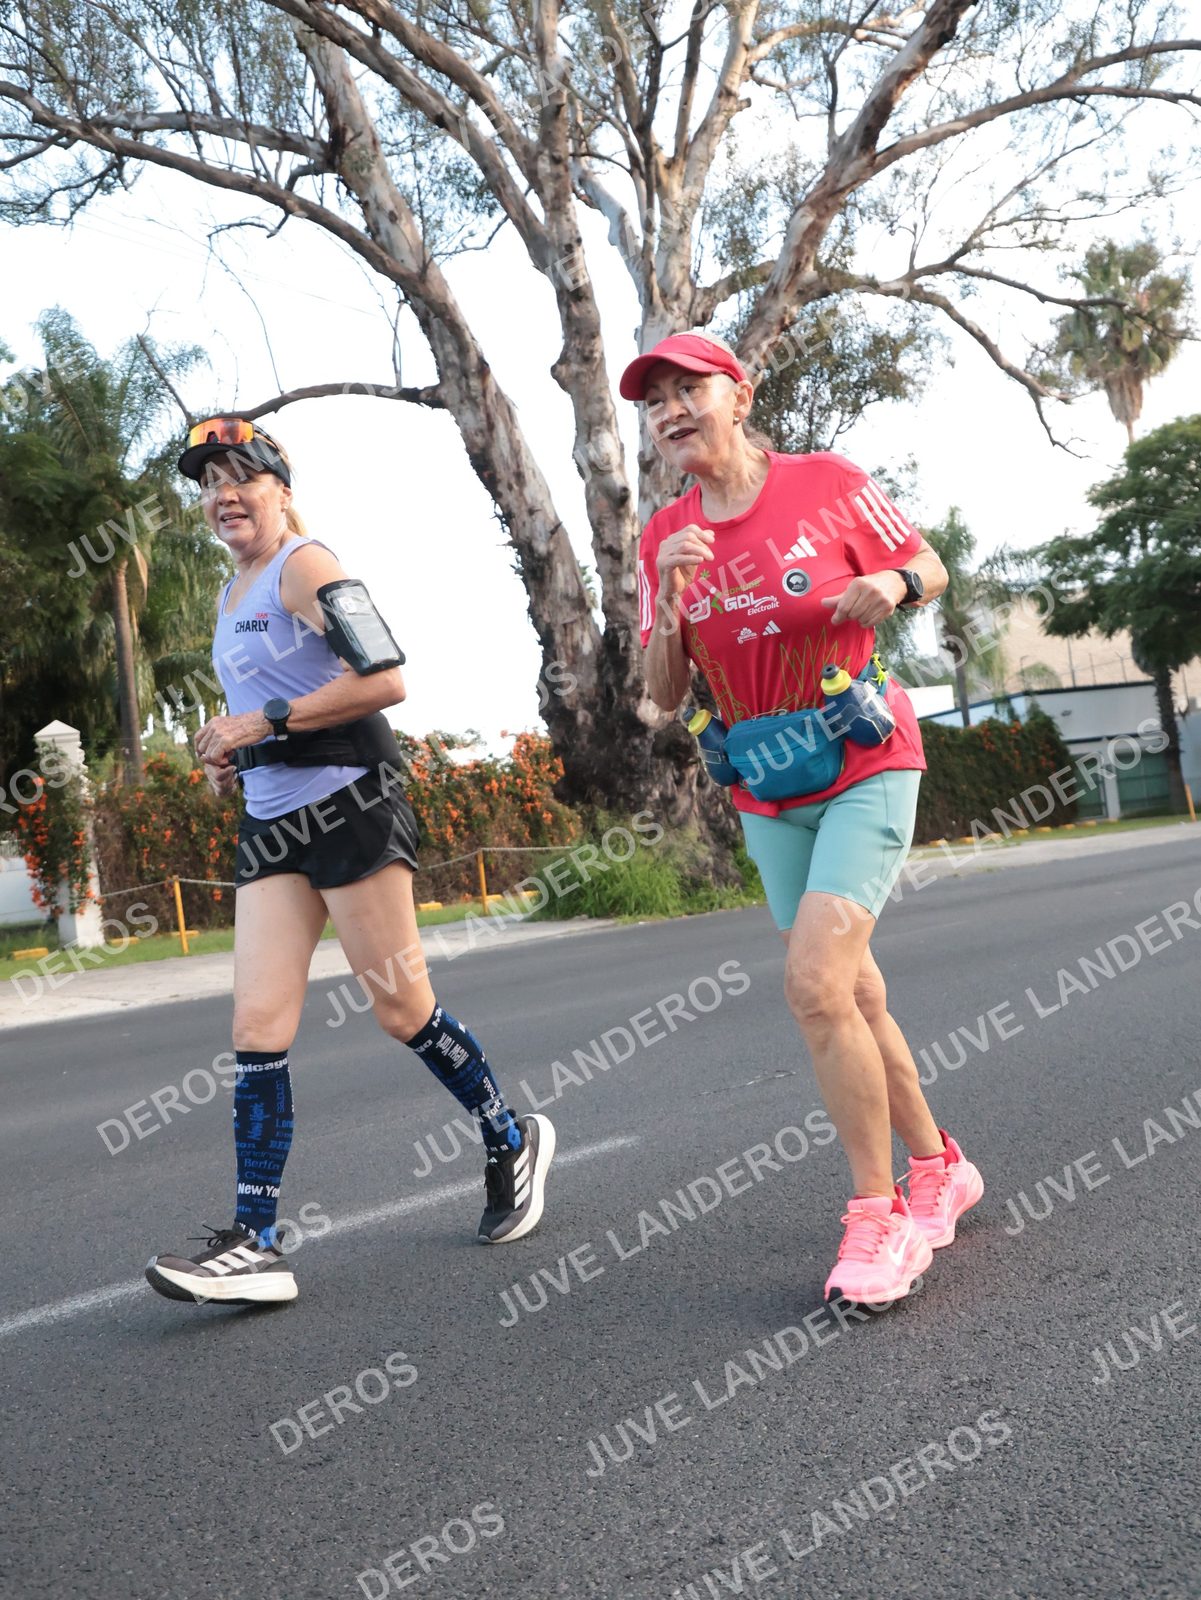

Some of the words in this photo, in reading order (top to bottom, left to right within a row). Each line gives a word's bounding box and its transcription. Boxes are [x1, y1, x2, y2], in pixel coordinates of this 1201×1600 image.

[747, 601, 780, 616] Electrolit
[235, 619, 269, 634] CHARLY
[237, 1182, 264, 1196] New
[265, 1184, 281, 1198] Yor
